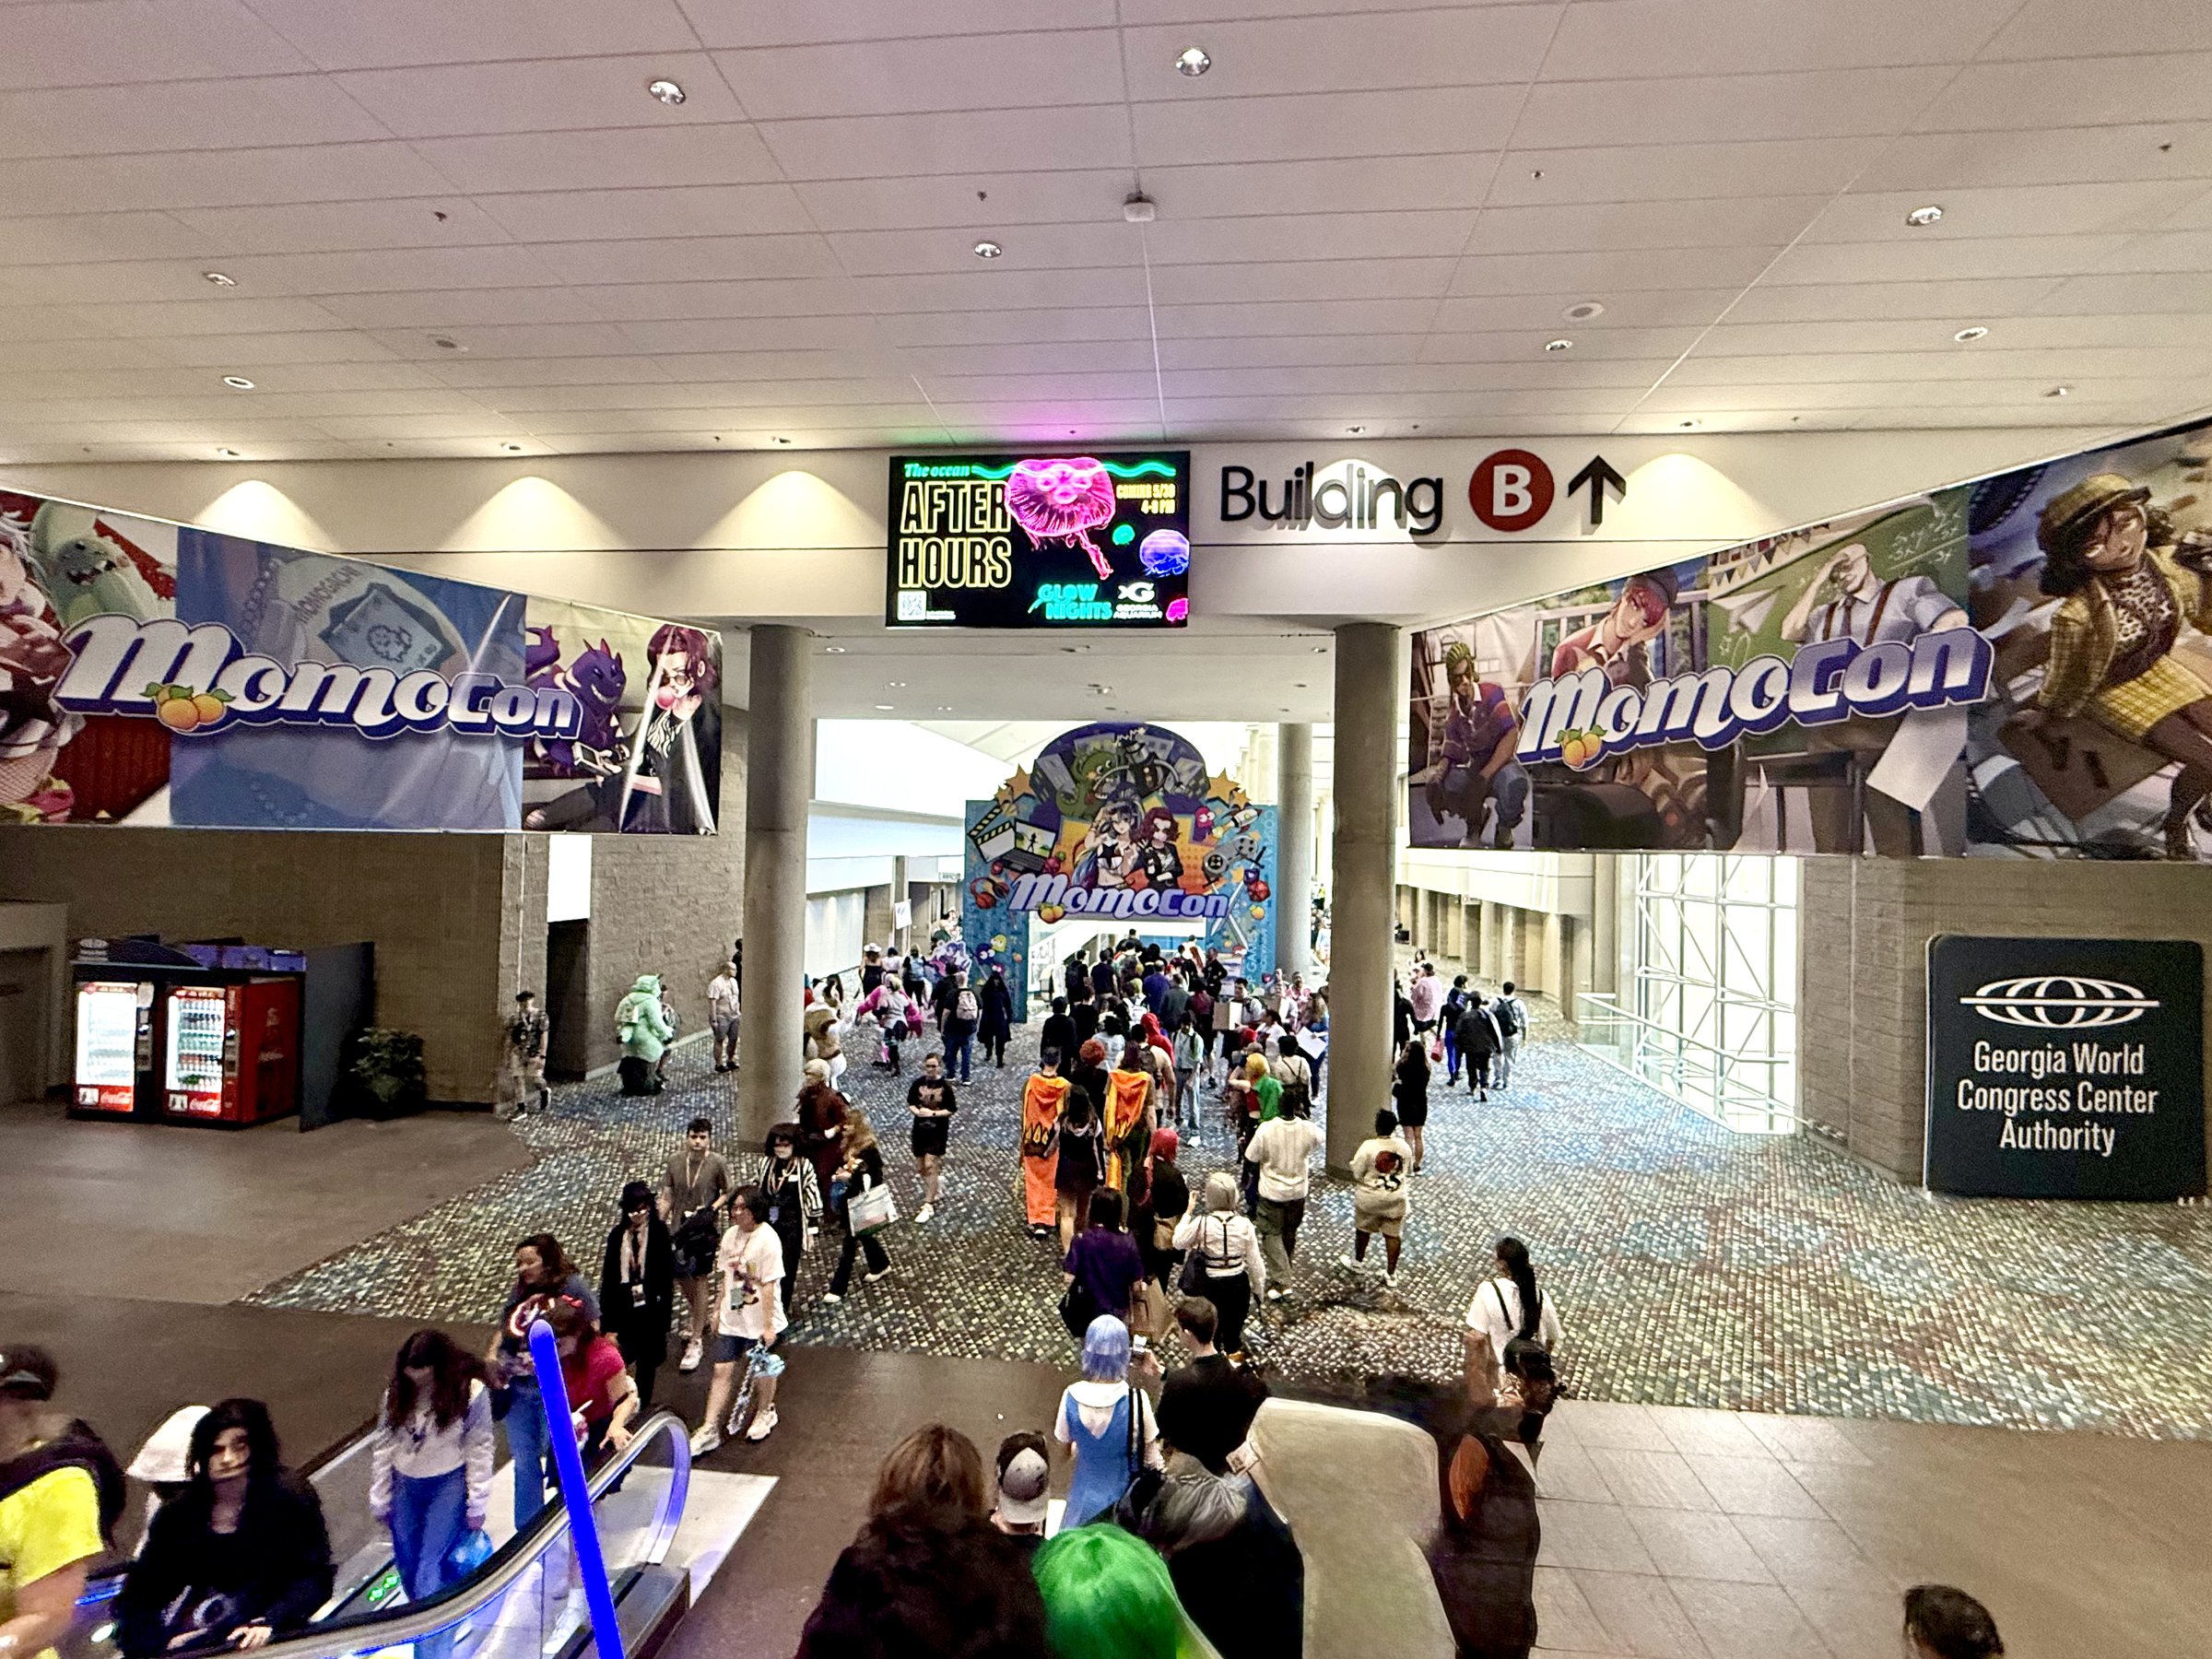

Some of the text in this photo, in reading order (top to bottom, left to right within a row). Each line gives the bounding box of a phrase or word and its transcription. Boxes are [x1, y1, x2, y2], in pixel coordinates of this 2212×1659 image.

[904, 463, 971, 477] The ocean
[900, 480, 1011, 533] AFTER
[1220, 461, 1533, 535] Building B
[899, 536, 1012, 588] HOURS
[1037, 583, 1099, 602] GLOW
[1045, 601, 1113, 620] NIGHTS
[1973, 1041, 2145, 1080] Georgia World
[1957, 1078, 2159, 1117] Congress Center
[1999, 1116, 2115, 1158] Authority
